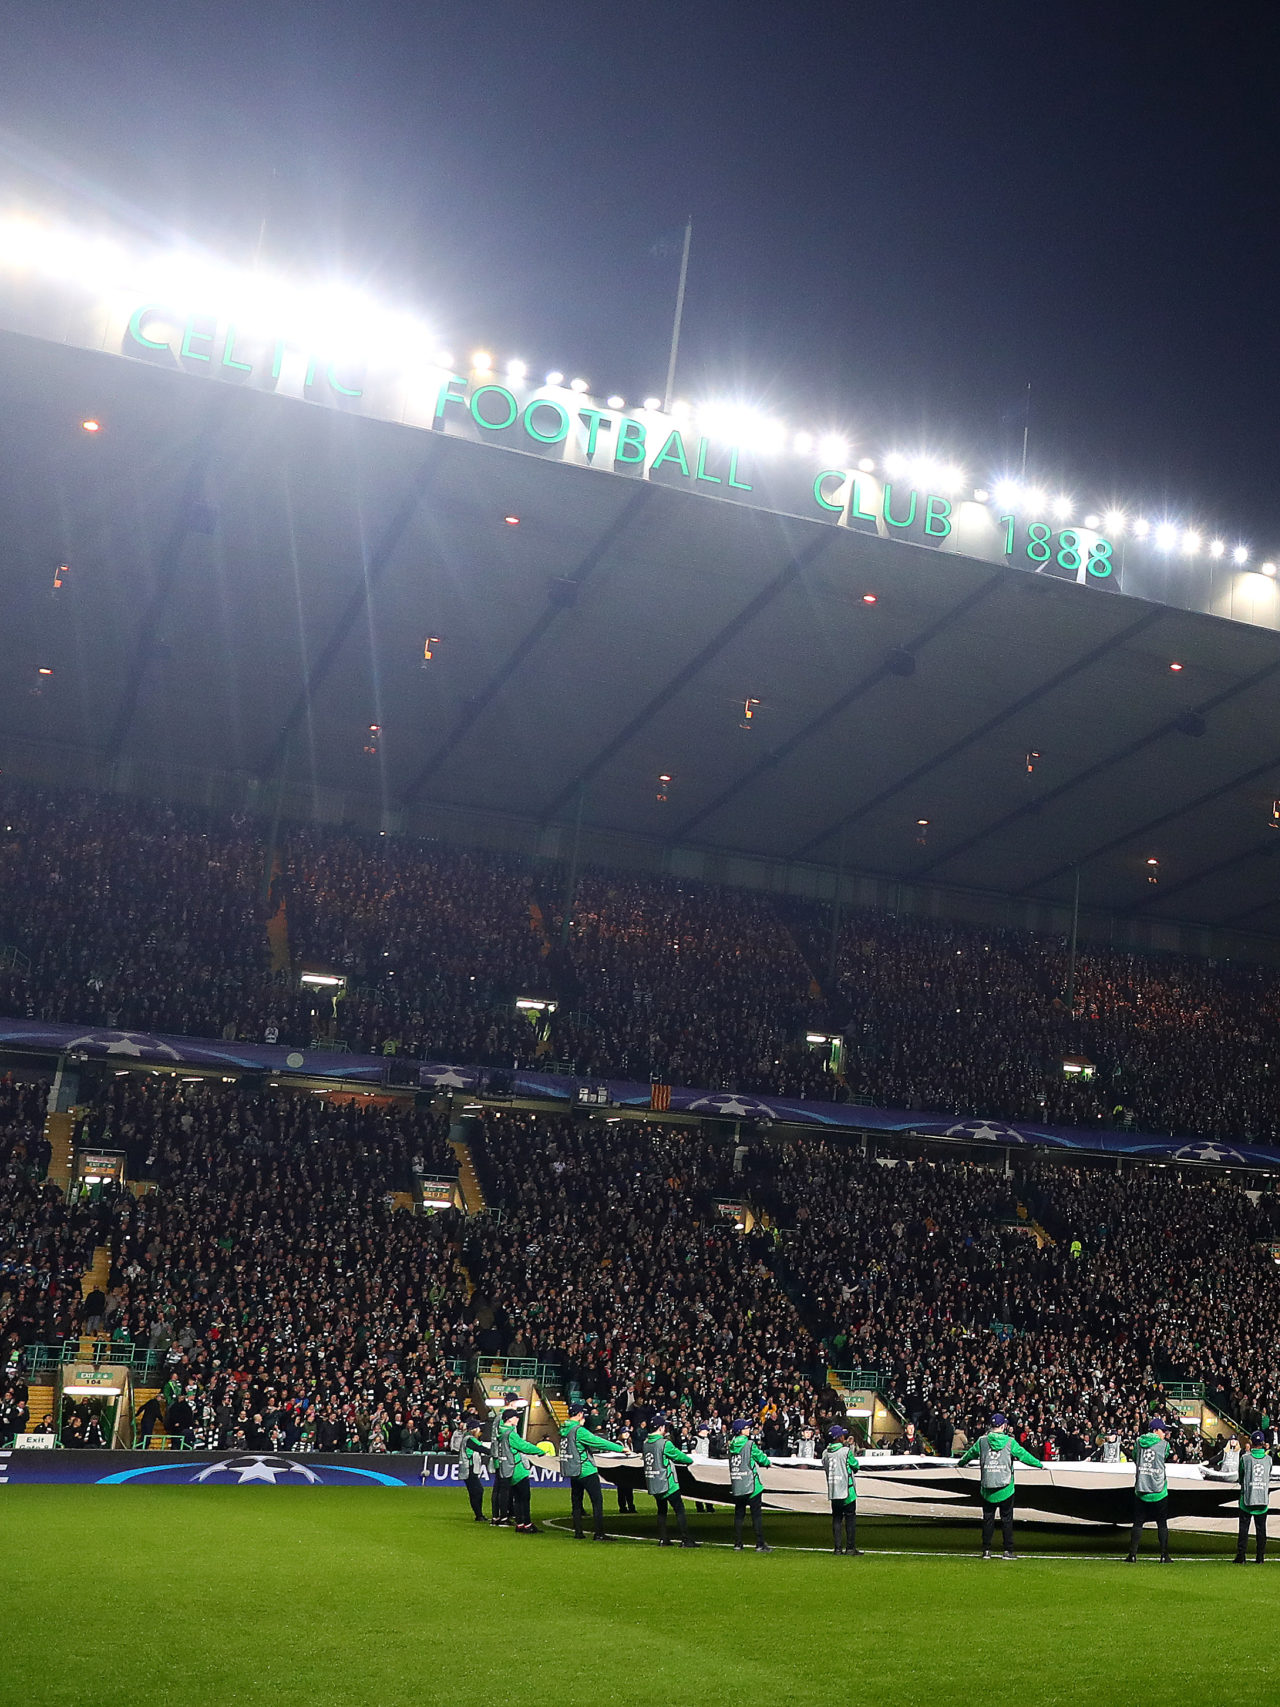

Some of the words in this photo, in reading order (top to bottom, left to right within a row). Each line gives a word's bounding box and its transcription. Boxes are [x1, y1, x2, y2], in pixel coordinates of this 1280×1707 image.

[436, 374, 752, 491] FOOTBALL
[812, 469, 952, 537] CLUB
[1000, 515, 1113, 578] 1888
